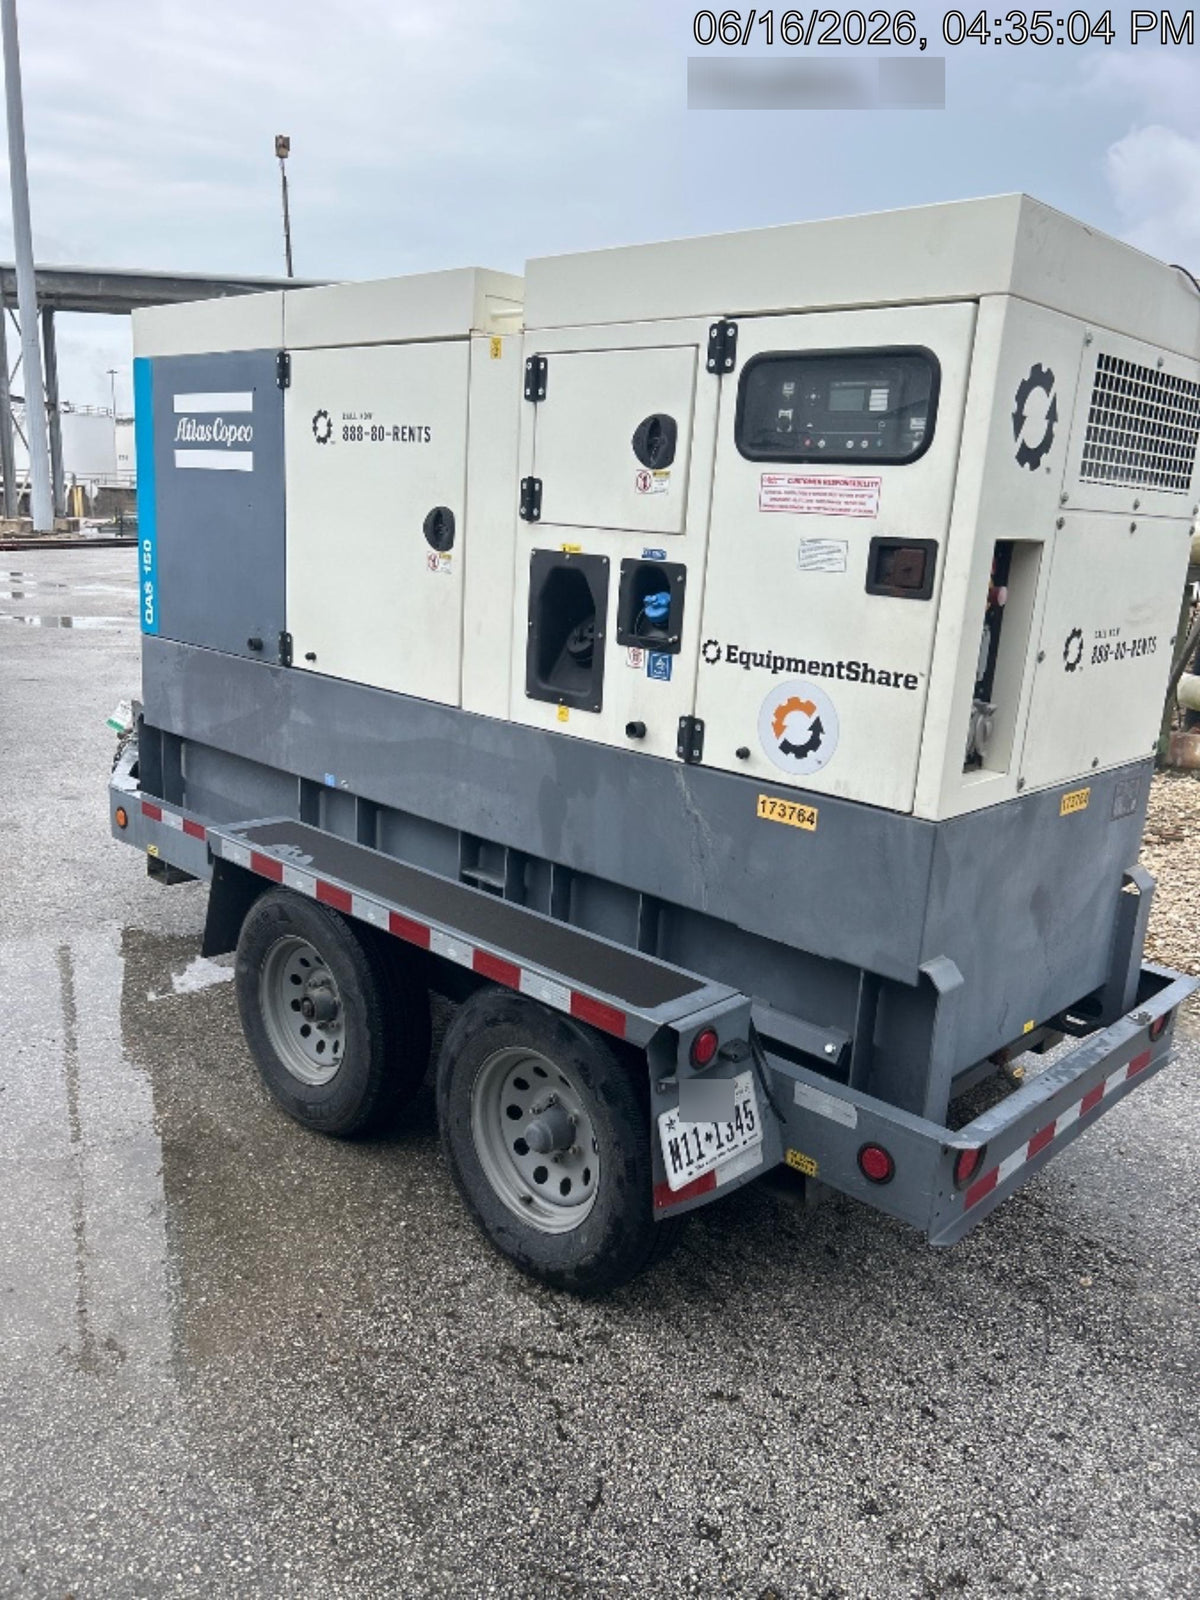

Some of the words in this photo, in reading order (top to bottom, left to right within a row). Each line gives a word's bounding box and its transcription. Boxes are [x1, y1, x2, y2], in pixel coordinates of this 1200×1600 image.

[342, 425, 431, 443] 888-80-RENTS
[143, 539, 152, 573] 150
[144, 581, 154, 624] QAS
[725, 644, 918, 690] EquipmentShare
[760, 800, 815, 825] 173764
